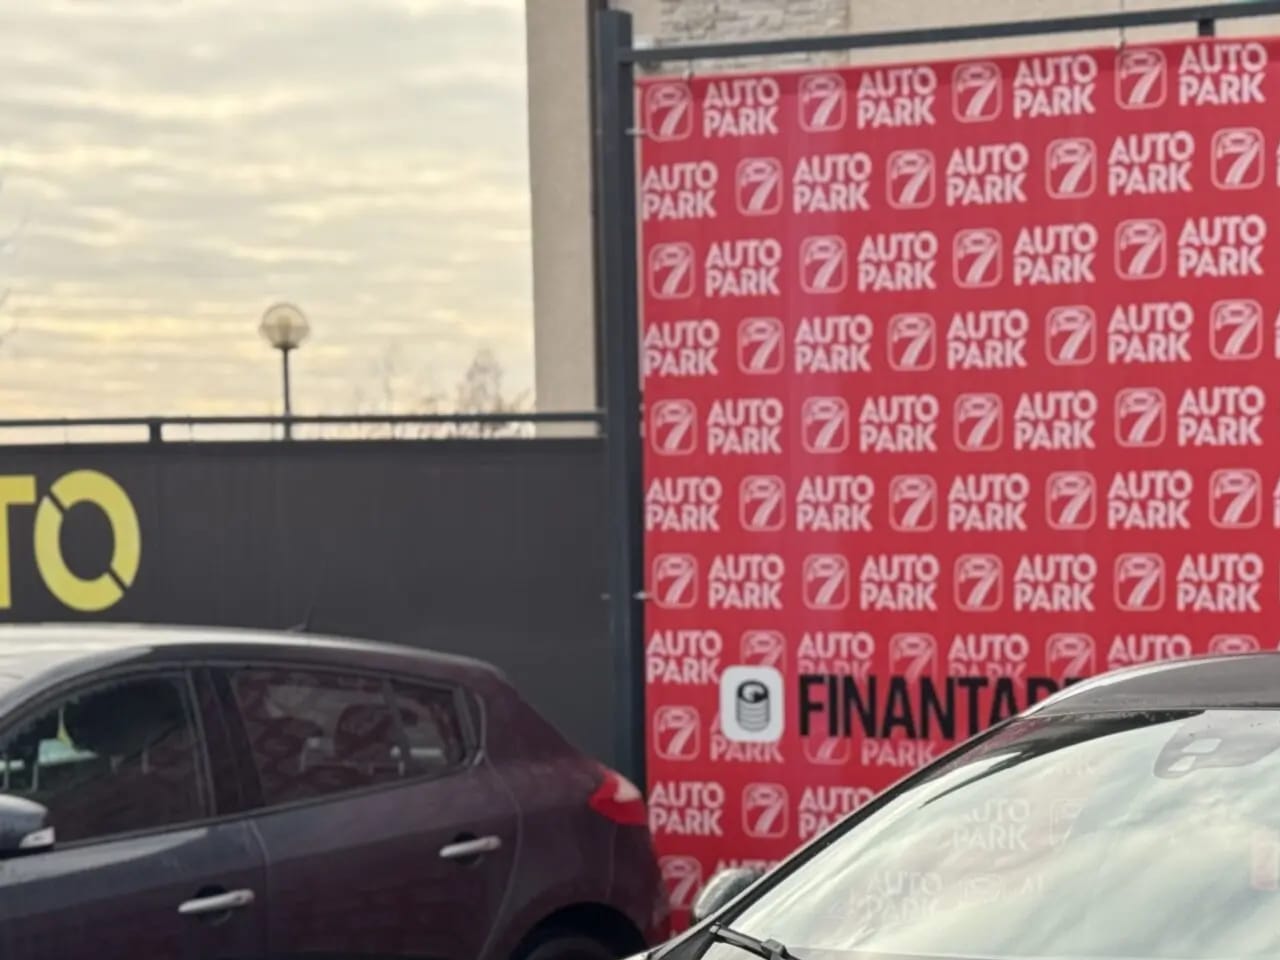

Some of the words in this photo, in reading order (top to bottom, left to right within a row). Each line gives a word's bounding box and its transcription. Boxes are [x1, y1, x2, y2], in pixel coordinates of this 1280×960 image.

[1013, 55, 1097, 86] AUTO
[1179, 43, 1267, 74] AUTO
[704, 79, 779, 108] AUTO
[857, 67, 937, 98] AUTO
[1180, 72, 1264, 105] PARK
[858, 95, 934, 128] PARK
[1014, 83, 1094, 118] PARK
[704, 106, 778, 137] PARK
[947, 143, 1028, 176] AUTO
[1109, 131, 1194, 165] AUTO
[642, 162, 718, 192] AUTO
[793, 153, 872, 184] AUTO
[1109, 161, 1192, 195] PARK
[794, 181, 869, 213] PARK
[947, 172, 1026, 206] PARK
[642, 191, 716, 220] PARK
[1014, 223, 1097, 256] AUTO
[1178, 215, 1266, 247] AUTO
[705, 239, 781, 268] AUTO
[858, 232, 937, 263] AUTO
[1179, 245, 1263, 277] PARK
[706, 267, 779, 296] PARK
[859, 260, 935, 291] PARK
[1014, 253, 1094, 285] PARK
[795, 315, 872, 345] AUTO
[947, 309, 1028, 340] AUTO
[1108, 302, 1193, 334] AUTO
[642, 320, 719, 348] AUTO
[1108, 331, 1190, 363] PARK
[643, 347, 717, 376] PARK
[795, 343, 870, 373] PARK
[948, 338, 1026, 369] PARK
[707, 398, 783, 426] AUTO
[860, 395, 938, 424] AUTO
[1014, 390, 1097, 421] AUTO
[1178, 386, 1264, 416] AUTO
[708, 426, 781, 454] PARK
[860, 423, 936, 451] PARK
[1015, 419, 1094, 449] PARK
[1178, 416, 1261, 446] PARK
[646, 477, 722, 504] AUTO
[797, 475, 874, 503] AUTO
[948, 473, 1029, 502] AUTO
[1108, 470, 1192, 500] AUTO
[645, 503, 719, 531] PARK
[797, 503, 872, 531] PARK
[948, 502, 1026, 531] PARK
[1108, 499, 1189, 529] PARK
[709, 555, 784, 582] AUTO
[861, 554, 939, 583] AUTO
[1014, 554, 1097, 583] AUTO
[1177, 554, 1263, 582] AUTO
[709, 580, 781, 608] PARK
[861, 581, 936, 610] PARK
[1014, 582, 1094, 611] PARK
[1177, 582, 1260, 612] PARK
[646, 630, 720, 657] AUTO
[798, 632, 874, 659] AUTO
[948, 634, 1029, 662] AUTO
[646, 656, 718, 684] PARK
[648, 781, 725, 809] AUTO
[648, 808, 722, 836] PARK
